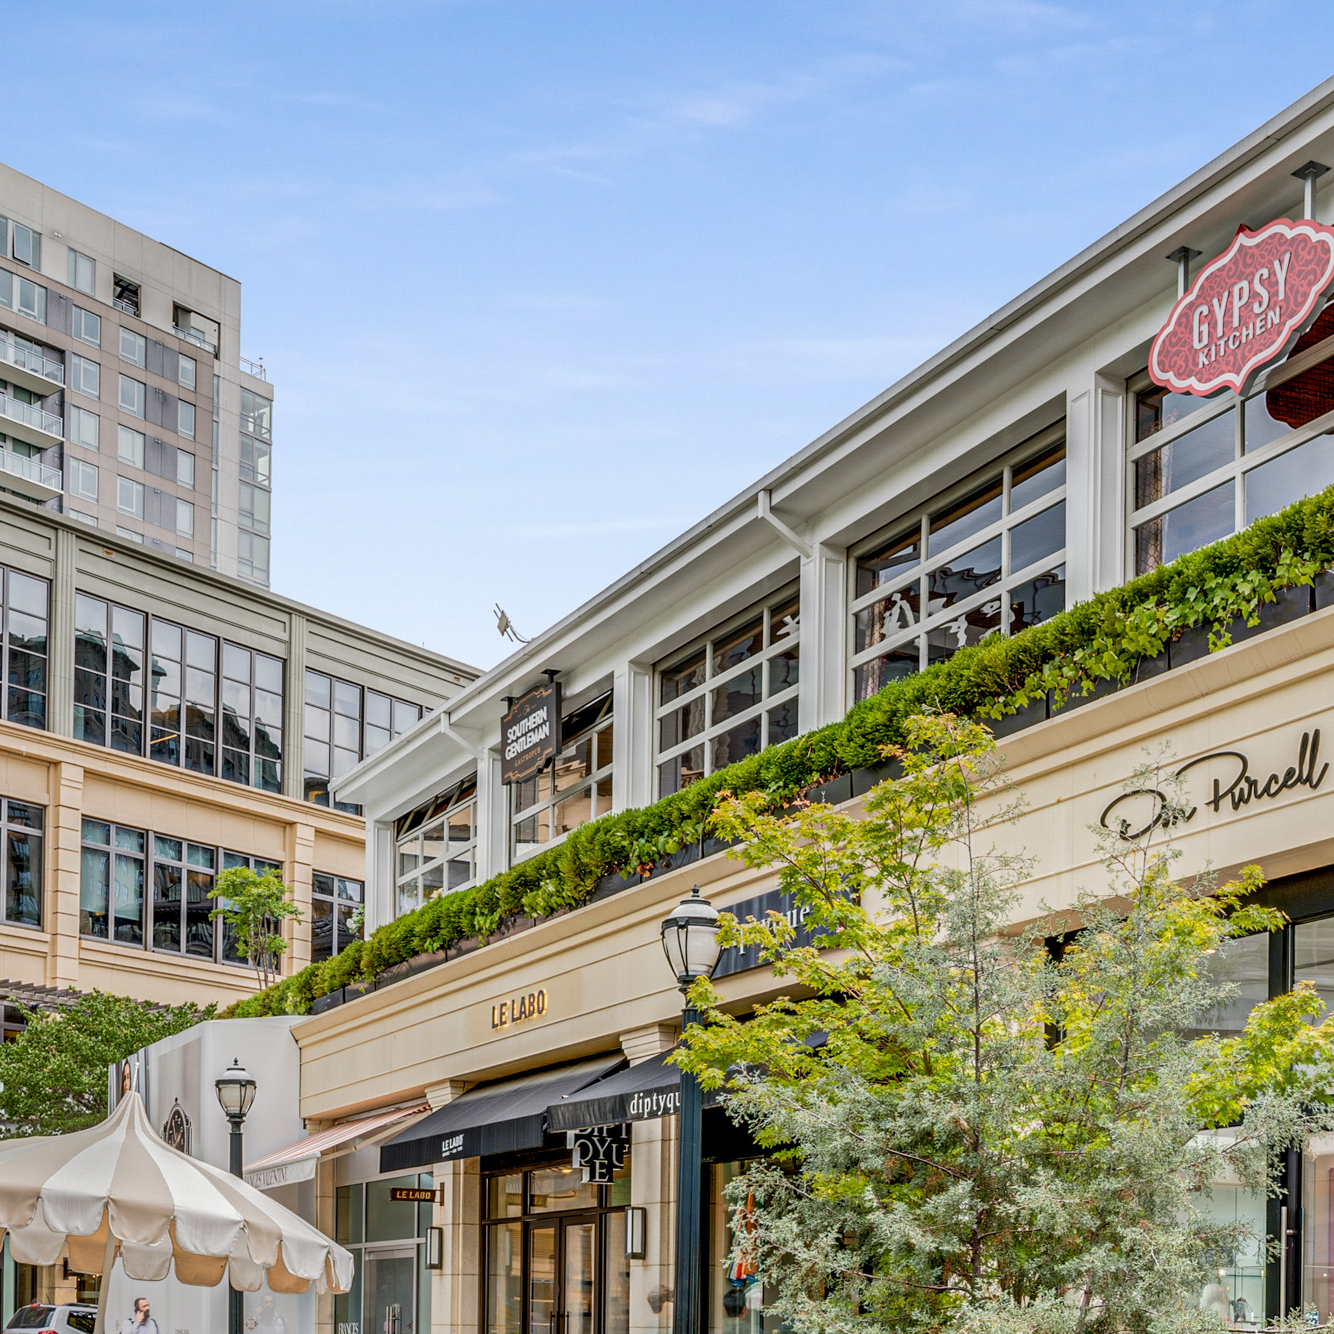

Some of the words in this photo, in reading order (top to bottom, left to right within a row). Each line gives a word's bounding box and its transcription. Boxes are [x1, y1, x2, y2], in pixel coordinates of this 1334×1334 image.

[1193, 251, 1291, 350] GYPSY
[1198, 305, 1282, 369] KITCHEN
[505, 722, 550, 760] GENTLEMAN
[507, 706, 547, 743] SOUTHERN
[1174, 728, 1330, 812] Purcell
[491, 1002, 509, 1029] LE
[511, 989, 547, 1023] LABO
[442, 1139, 450, 1152] LE
[450, 1133, 464, 1149] LABO
[396, 1190, 408, 1199] LE
[409, 1190, 432, 1200] LABO
